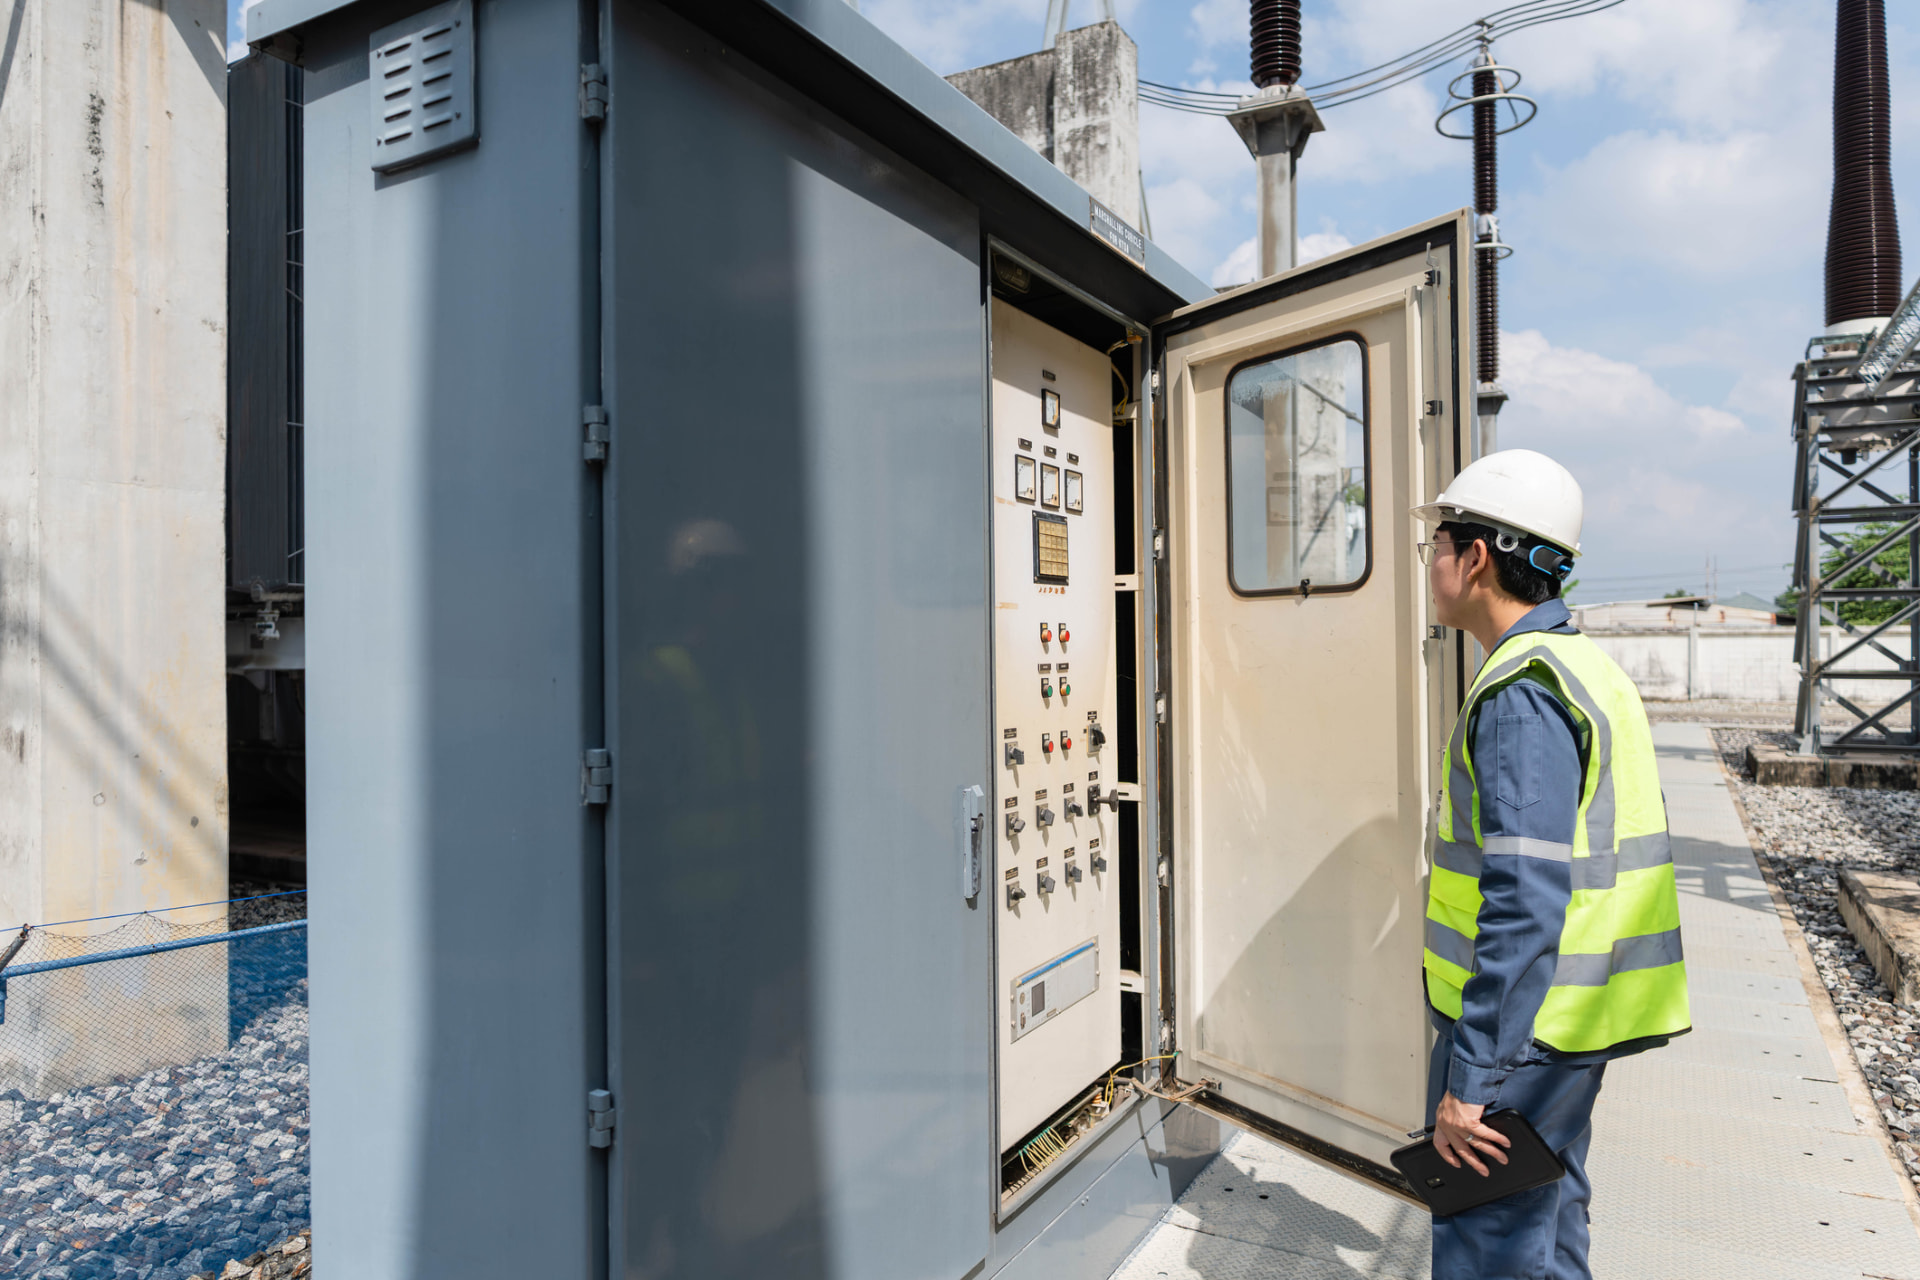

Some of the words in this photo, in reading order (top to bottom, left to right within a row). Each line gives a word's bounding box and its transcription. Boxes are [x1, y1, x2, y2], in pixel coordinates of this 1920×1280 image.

[1094, 204, 1124, 236] MARSHALLING
[1125, 229, 1142, 249] CUBICLE
[1109, 231, 1118, 246] FOR
